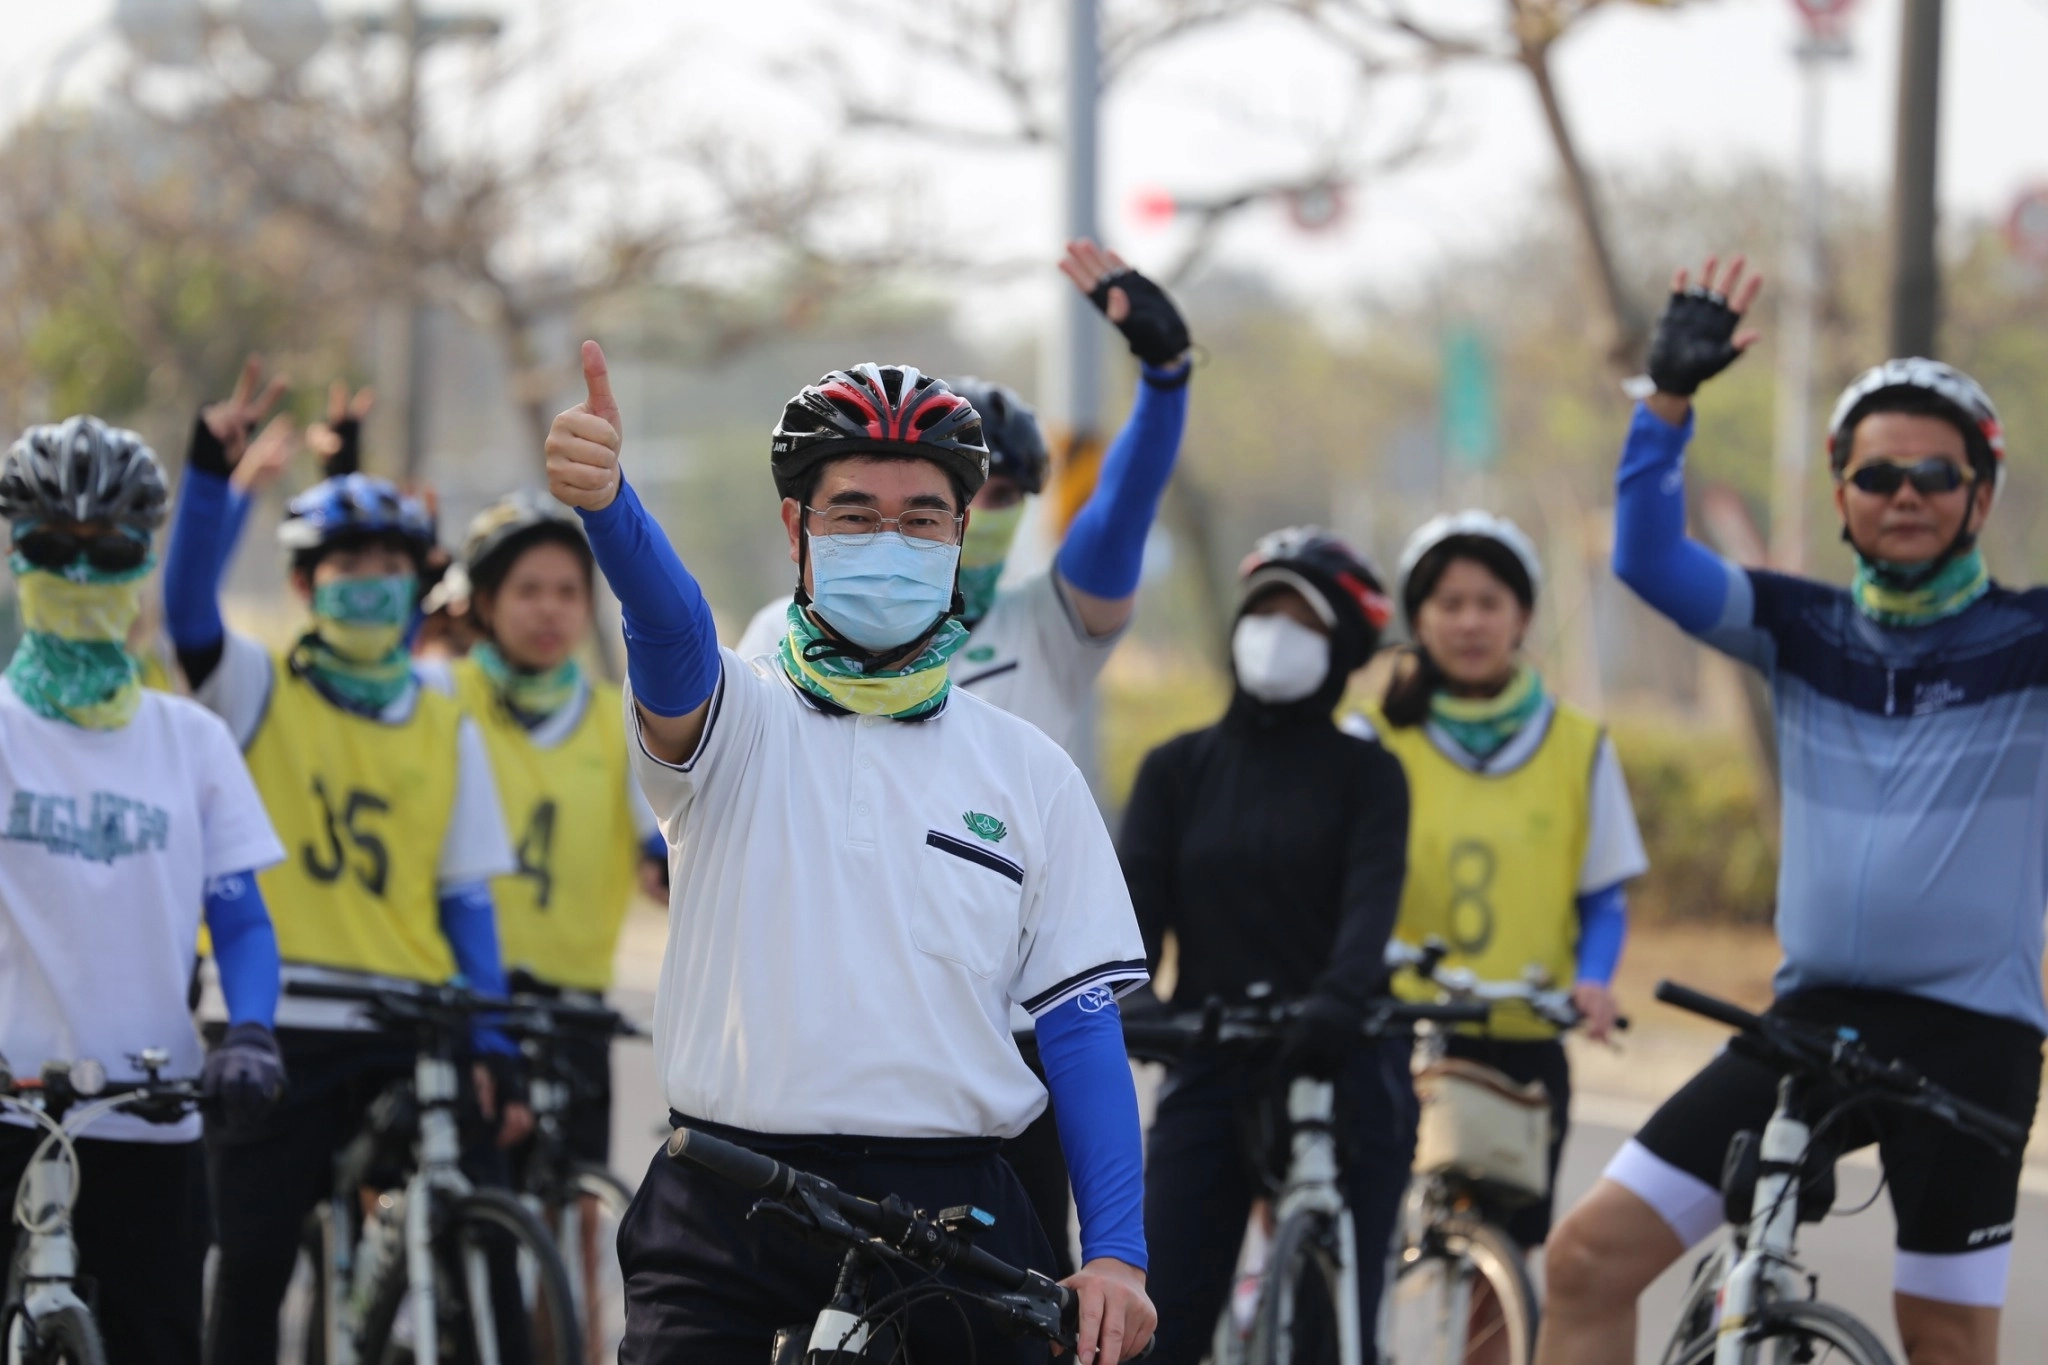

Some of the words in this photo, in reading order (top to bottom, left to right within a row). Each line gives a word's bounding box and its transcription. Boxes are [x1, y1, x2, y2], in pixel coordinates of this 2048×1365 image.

[773, 441, 788, 452] ANT
[516, 799, 557, 910] 4
[1446, 838, 1499, 957] 8
